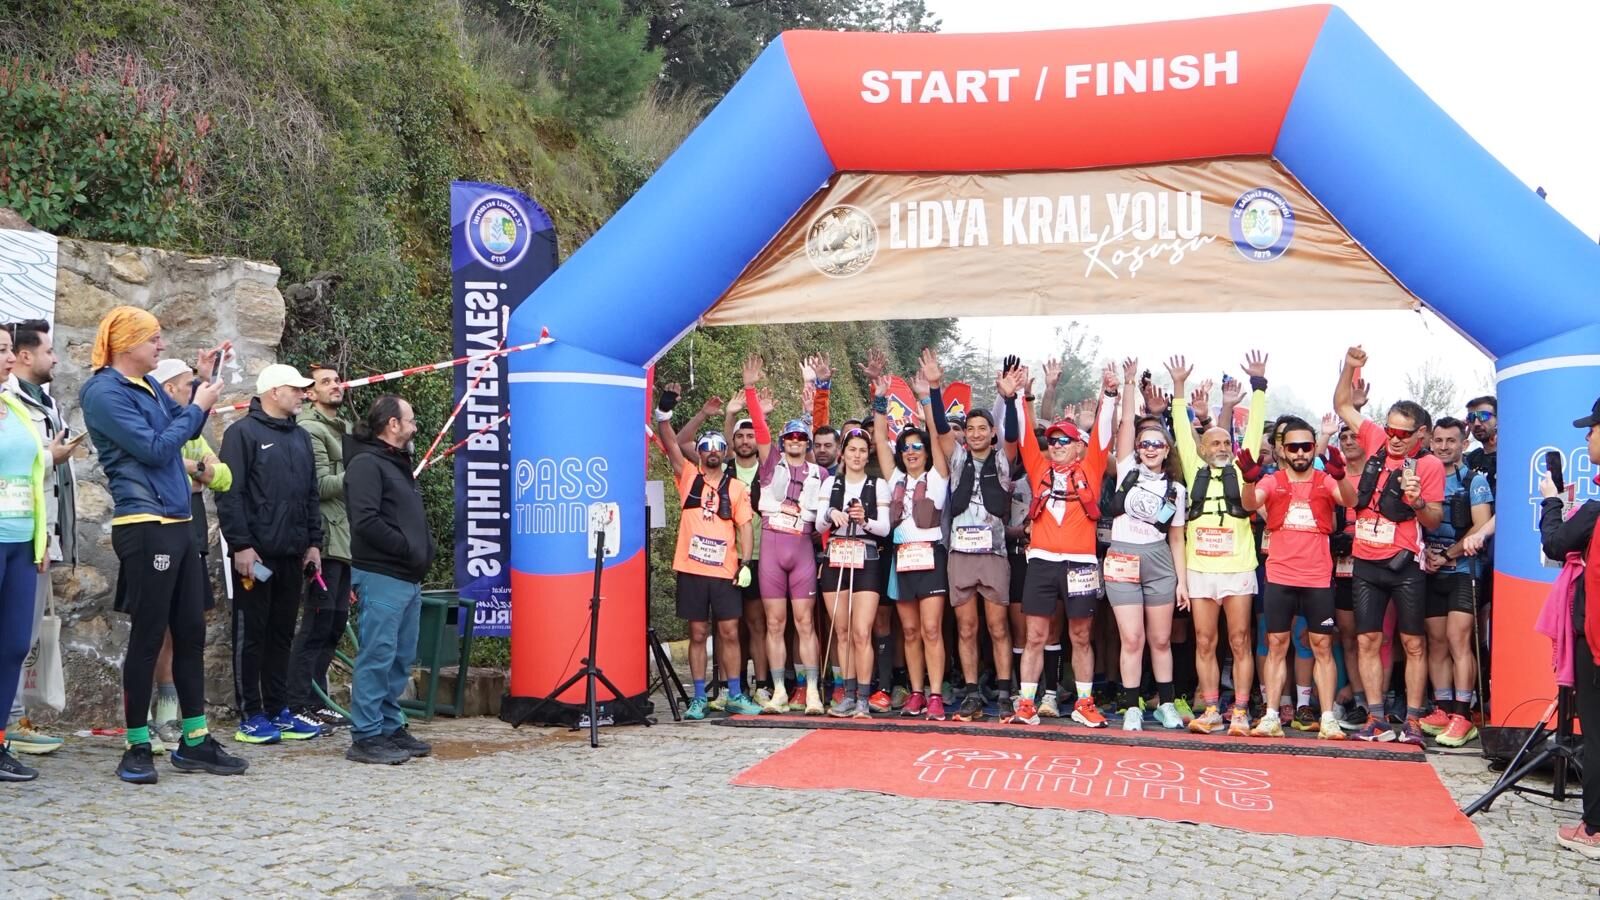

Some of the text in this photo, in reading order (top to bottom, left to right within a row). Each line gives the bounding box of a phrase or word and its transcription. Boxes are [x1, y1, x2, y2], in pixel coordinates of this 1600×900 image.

[861, 50, 1238, 104] START / FINISH
[1003, 194, 1099, 245] KRAL
[1105, 190, 1201, 241] YOLU
[1083, 220, 1217, 280] Koşusu
[515, 456, 609, 500] PASS
[515, 502, 588, 535] TIMIN
